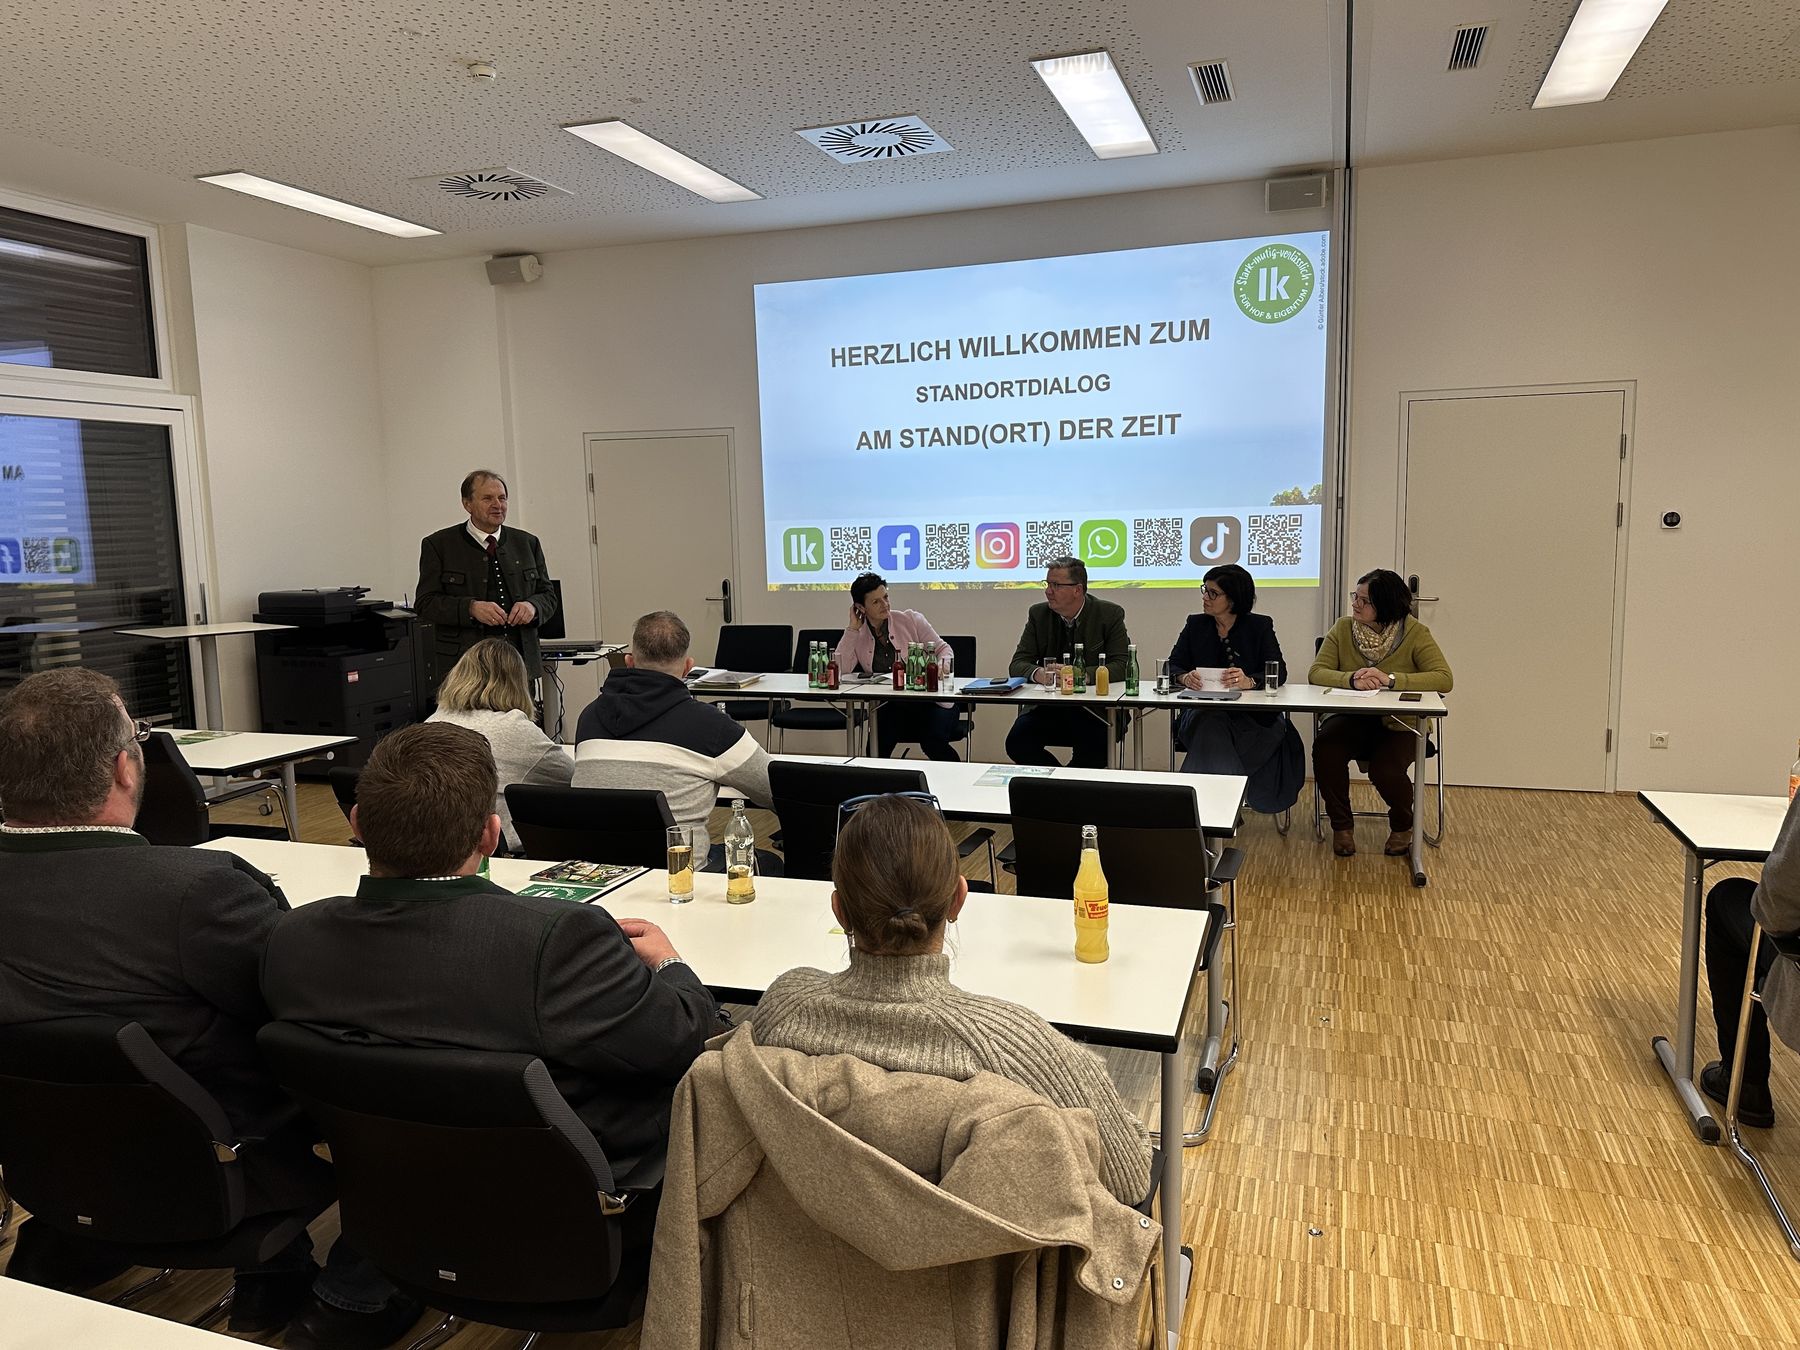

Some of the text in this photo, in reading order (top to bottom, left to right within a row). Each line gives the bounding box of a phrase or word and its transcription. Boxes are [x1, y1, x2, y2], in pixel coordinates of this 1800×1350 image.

[1258, 266, 1290, 302] lk
[1240, 288, 1308, 320] FÜR HOF & EIGENTUM
[831, 318, 1210, 368] HERZLICH WILLKOMMEN ZUM
[915, 374, 1111, 403] STANDORTDIALOG
[855, 413, 1182, 451] AM STAND(ORT) DER ZEIT
[790, 534, 818, 565] lk
